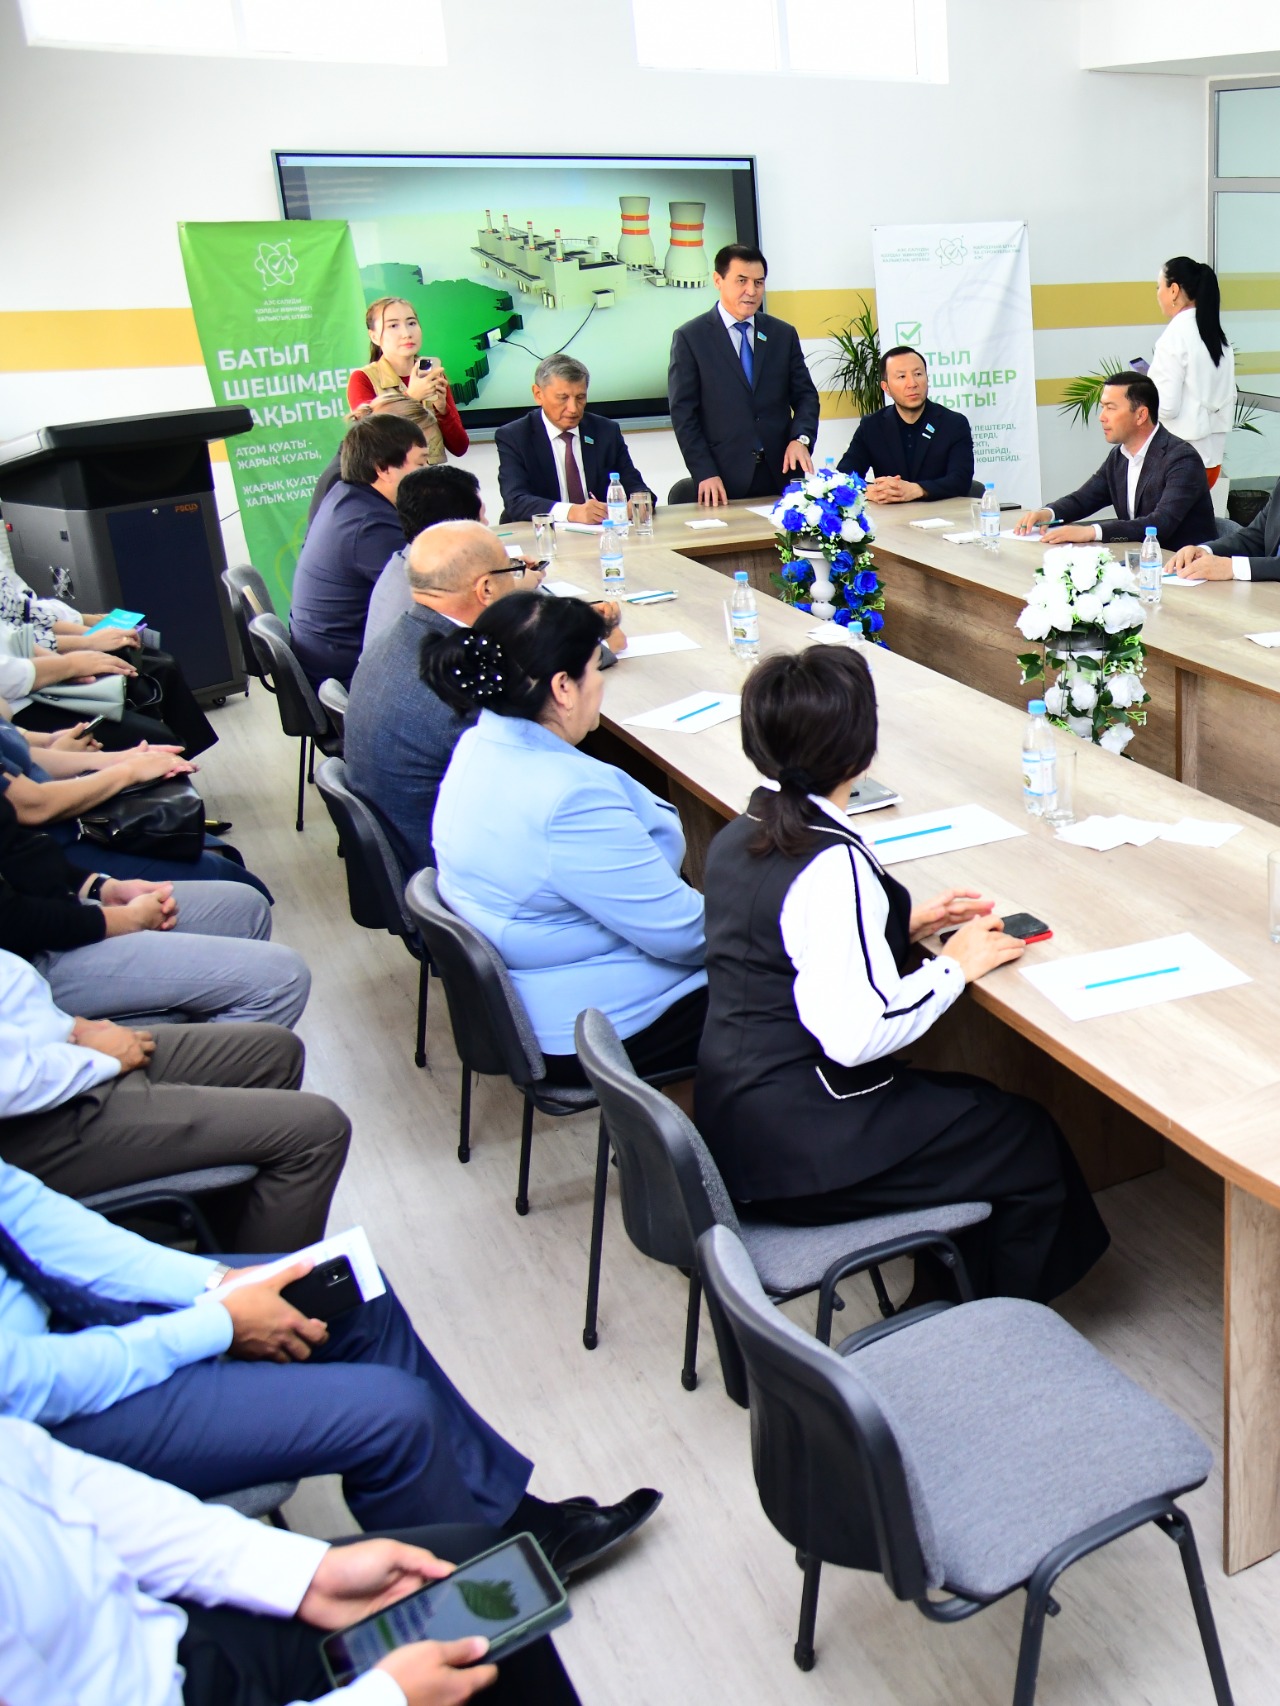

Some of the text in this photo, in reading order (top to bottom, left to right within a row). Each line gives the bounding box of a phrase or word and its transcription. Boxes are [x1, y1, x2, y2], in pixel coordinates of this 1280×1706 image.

[218, 344, 310, 371] БАТЫЛ
[924, 350, 971, 366] ТЫЛ
[927, 369, 1017, 389] ШІМДЕР
[249, 398, 345, 429] АҚЫТЫ!
[235, 444, 267, 457] АТОМ
[268, 439, 307, 454] ҚУАТЫ
[237, 450, 322, 470] ЖАРЫҚ ҚУАТЫ,
[242, 480, 285, 495] ЖАРЫҚ
[245, 487, 315, 508] ХАЛЫҚ ҚУАТ
